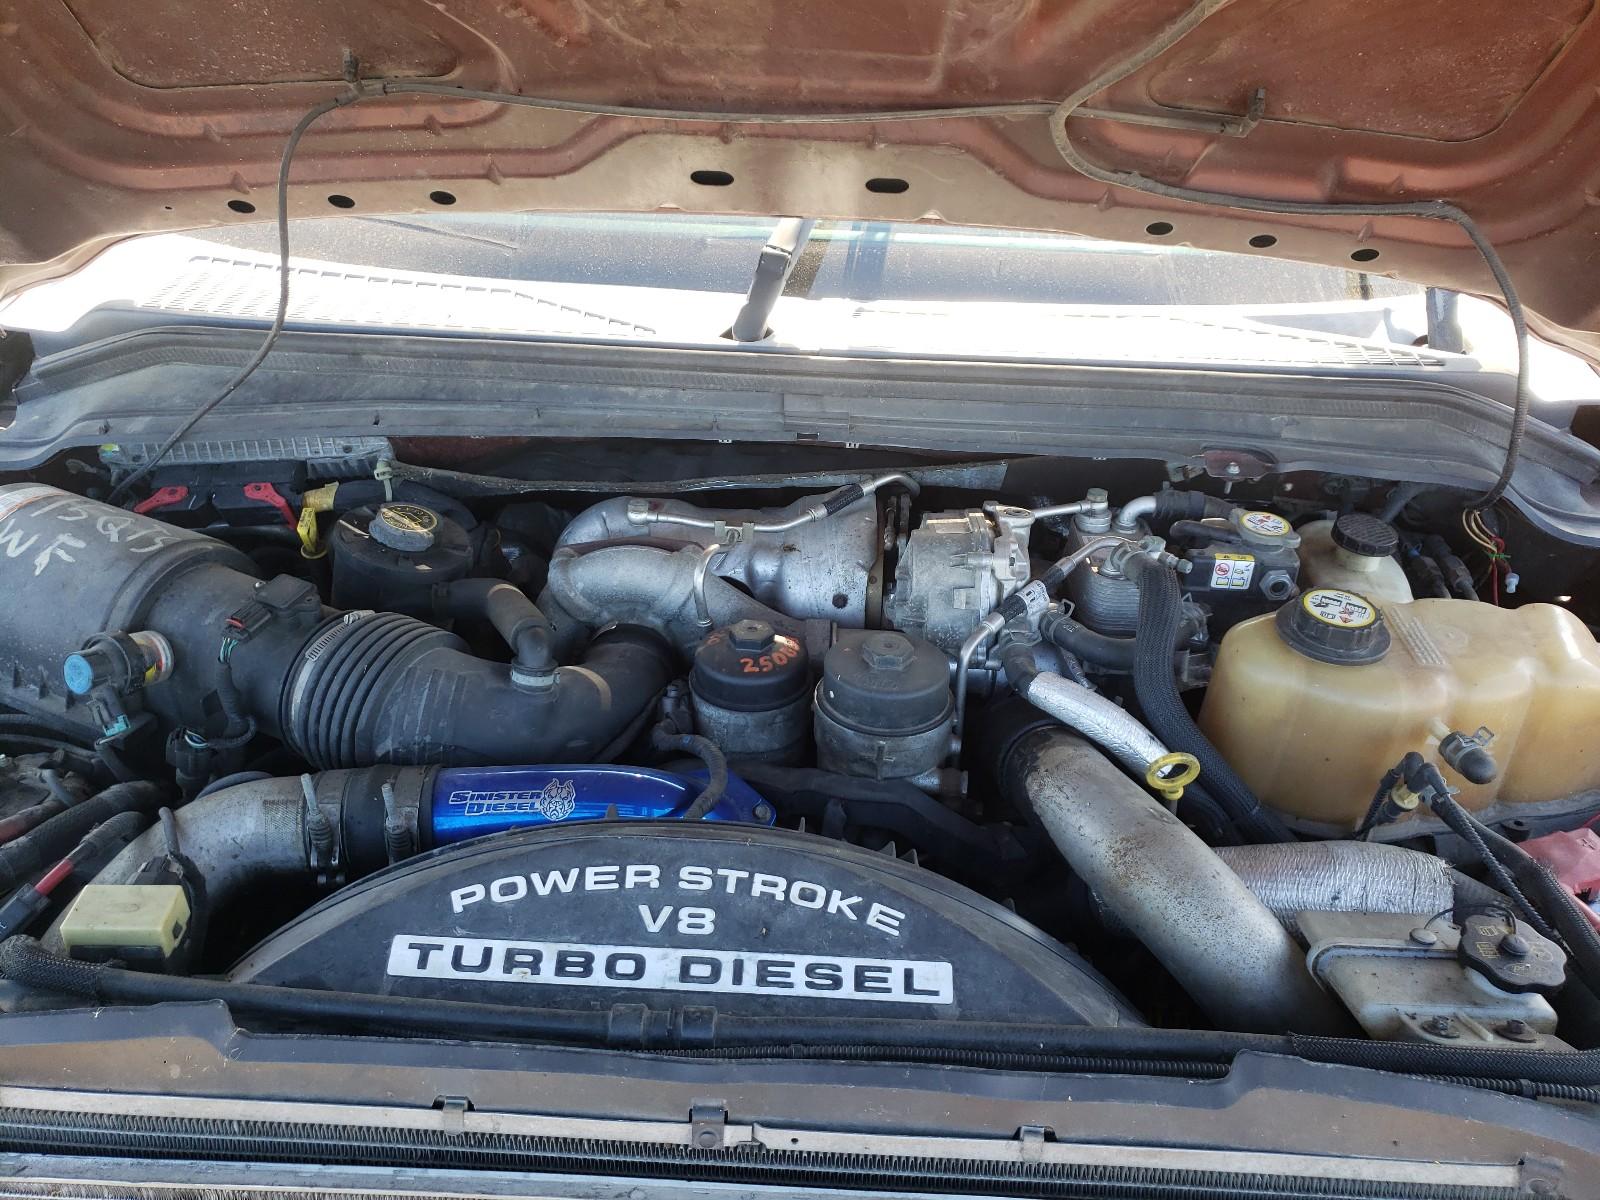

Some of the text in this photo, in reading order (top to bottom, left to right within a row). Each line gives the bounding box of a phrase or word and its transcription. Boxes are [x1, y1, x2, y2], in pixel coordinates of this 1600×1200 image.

[449, 790, 543, 804] SINISTER
[465, 801, 541, 816] DIESEL
[450, 864, 906, 938] POWER STROKE
[637, 904, 717, 936] V8
[407, 942, 942, 998] TURBO DIESEL
